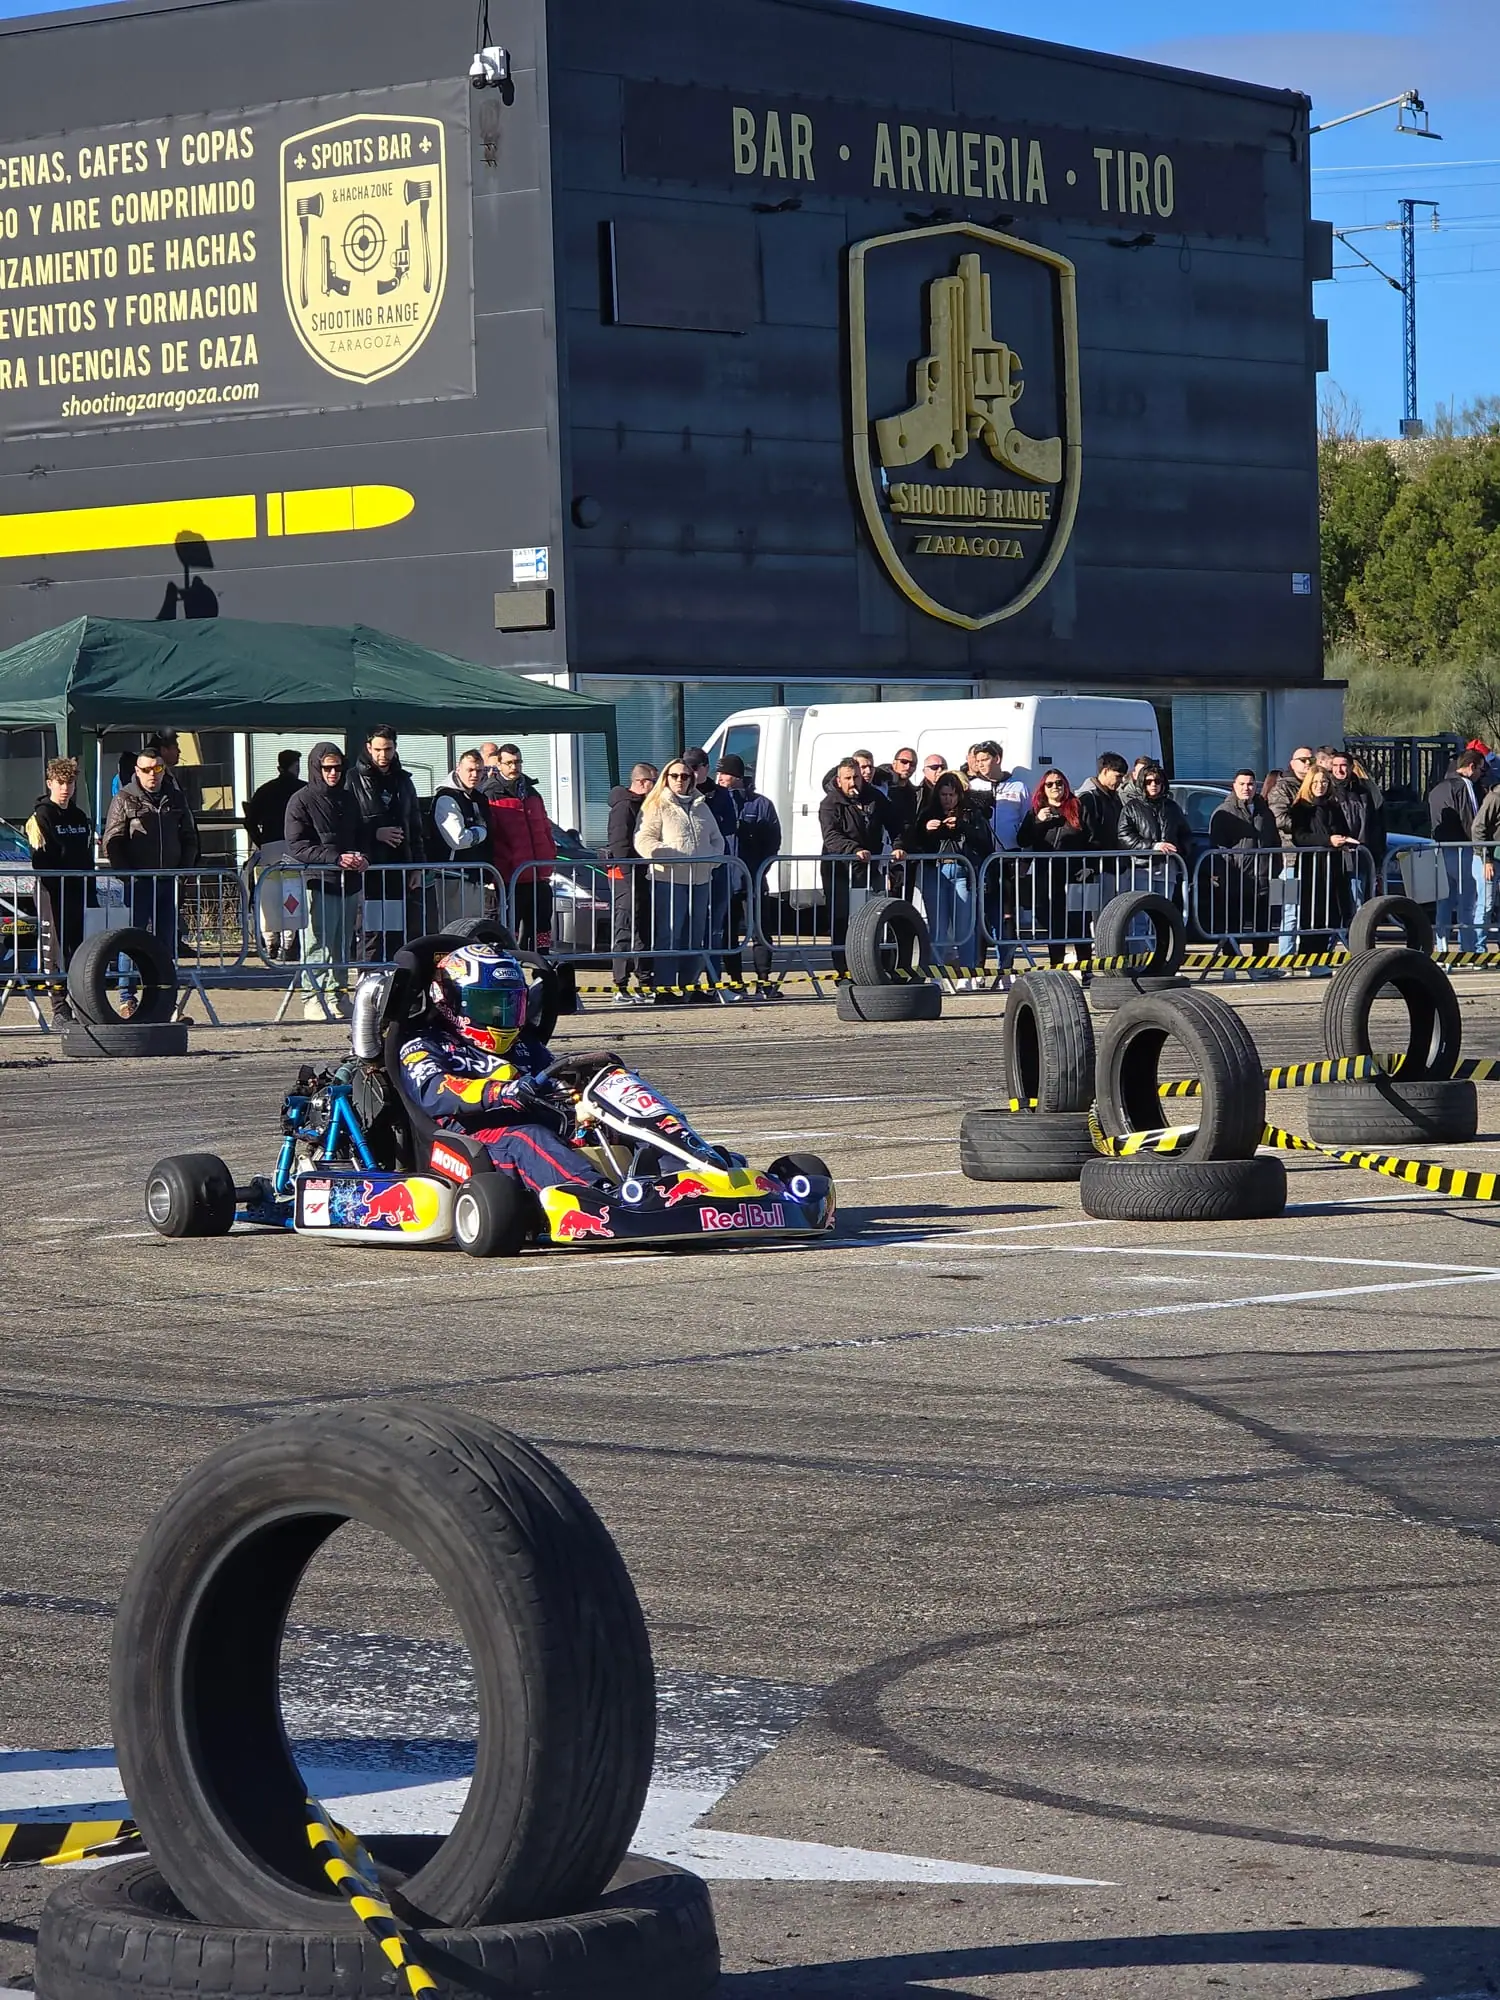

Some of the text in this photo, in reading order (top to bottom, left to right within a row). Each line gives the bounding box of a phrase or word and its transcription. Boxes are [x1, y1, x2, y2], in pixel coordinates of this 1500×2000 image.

[79, 141, 149, 180] CAFES
[157, 136, 170, 169] Y
[182, 127, 254, 167] COPAS
[311, 132, 412, 170] SPORTS BAR
[732, 106, 1174, 217] BAR ARMERIA TIRO
[29, 204, 42, 236] Y
[52, 197, 101, 234] AIRE
[112, 178, 255, 226] COMPRIMIDO
[128, 241, 156, 275] DE
[166, 229, 257, 271] HACHAS
[105, 297, 118, 329] Y
[126, 281, 258, 327] FORMACION
[311, 302, 419, 332] SHOOTING RANGE
[38, 344, 151, 386] LICENCIAS
[162, 340, 189, 374] DE
[200, 333, 259, 370] CAZA
[330, 334, 402, 353] ZARAGOZA
[62, 383, 260, 418] shootingzaragoza.com
[891, 482, 1051, 520] SHOOTING RANGE
[914, 535, 1025, 559] ZARAGOZA
[432, 1148, 469, 1180] MOTUL
